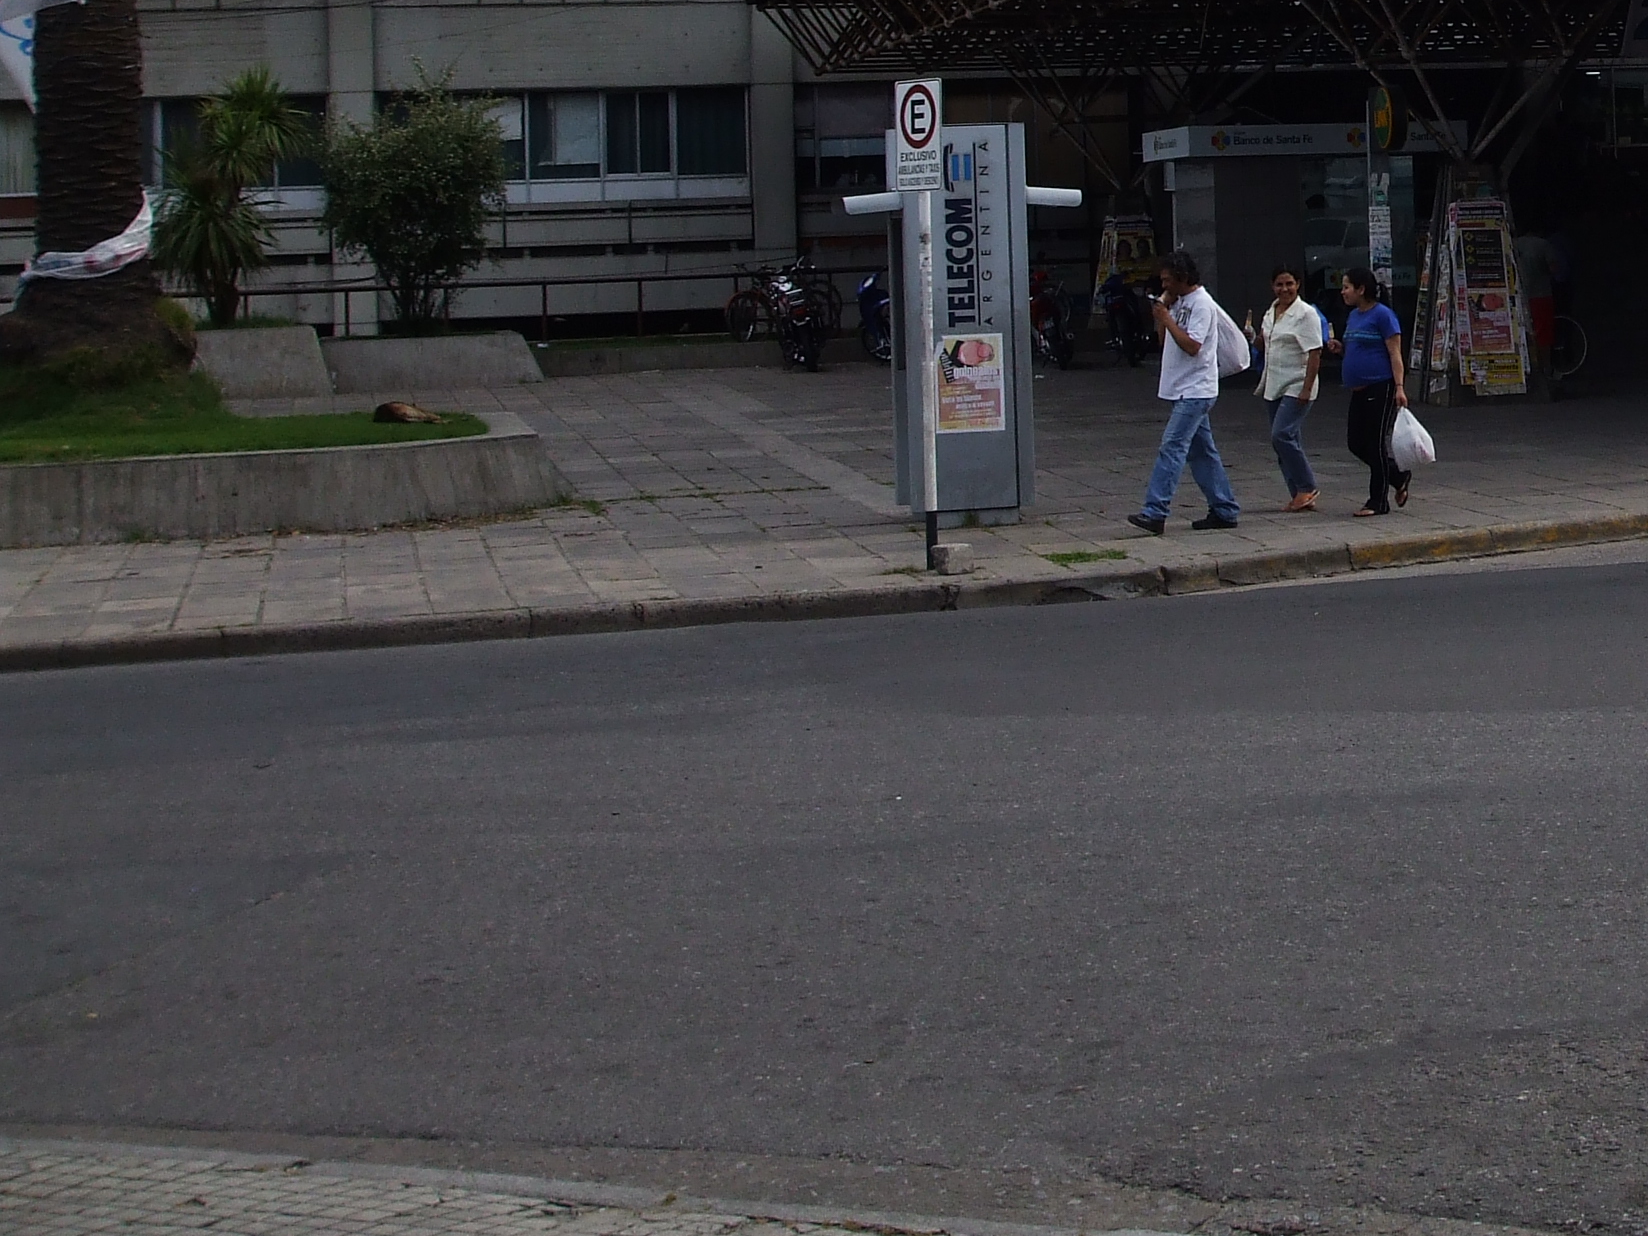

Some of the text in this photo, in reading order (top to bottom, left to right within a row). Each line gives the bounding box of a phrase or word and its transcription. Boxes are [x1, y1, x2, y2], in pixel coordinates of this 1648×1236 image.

[910, 98, 926, 135] E
[900, 150, 937, 162] EXCLUSIVO
[1233, 134, 1313, 145] Banco de Santa Fe
[979, 142, 994, 326] ARGENTINA
[945, 198, 976, 328] TELECOM
